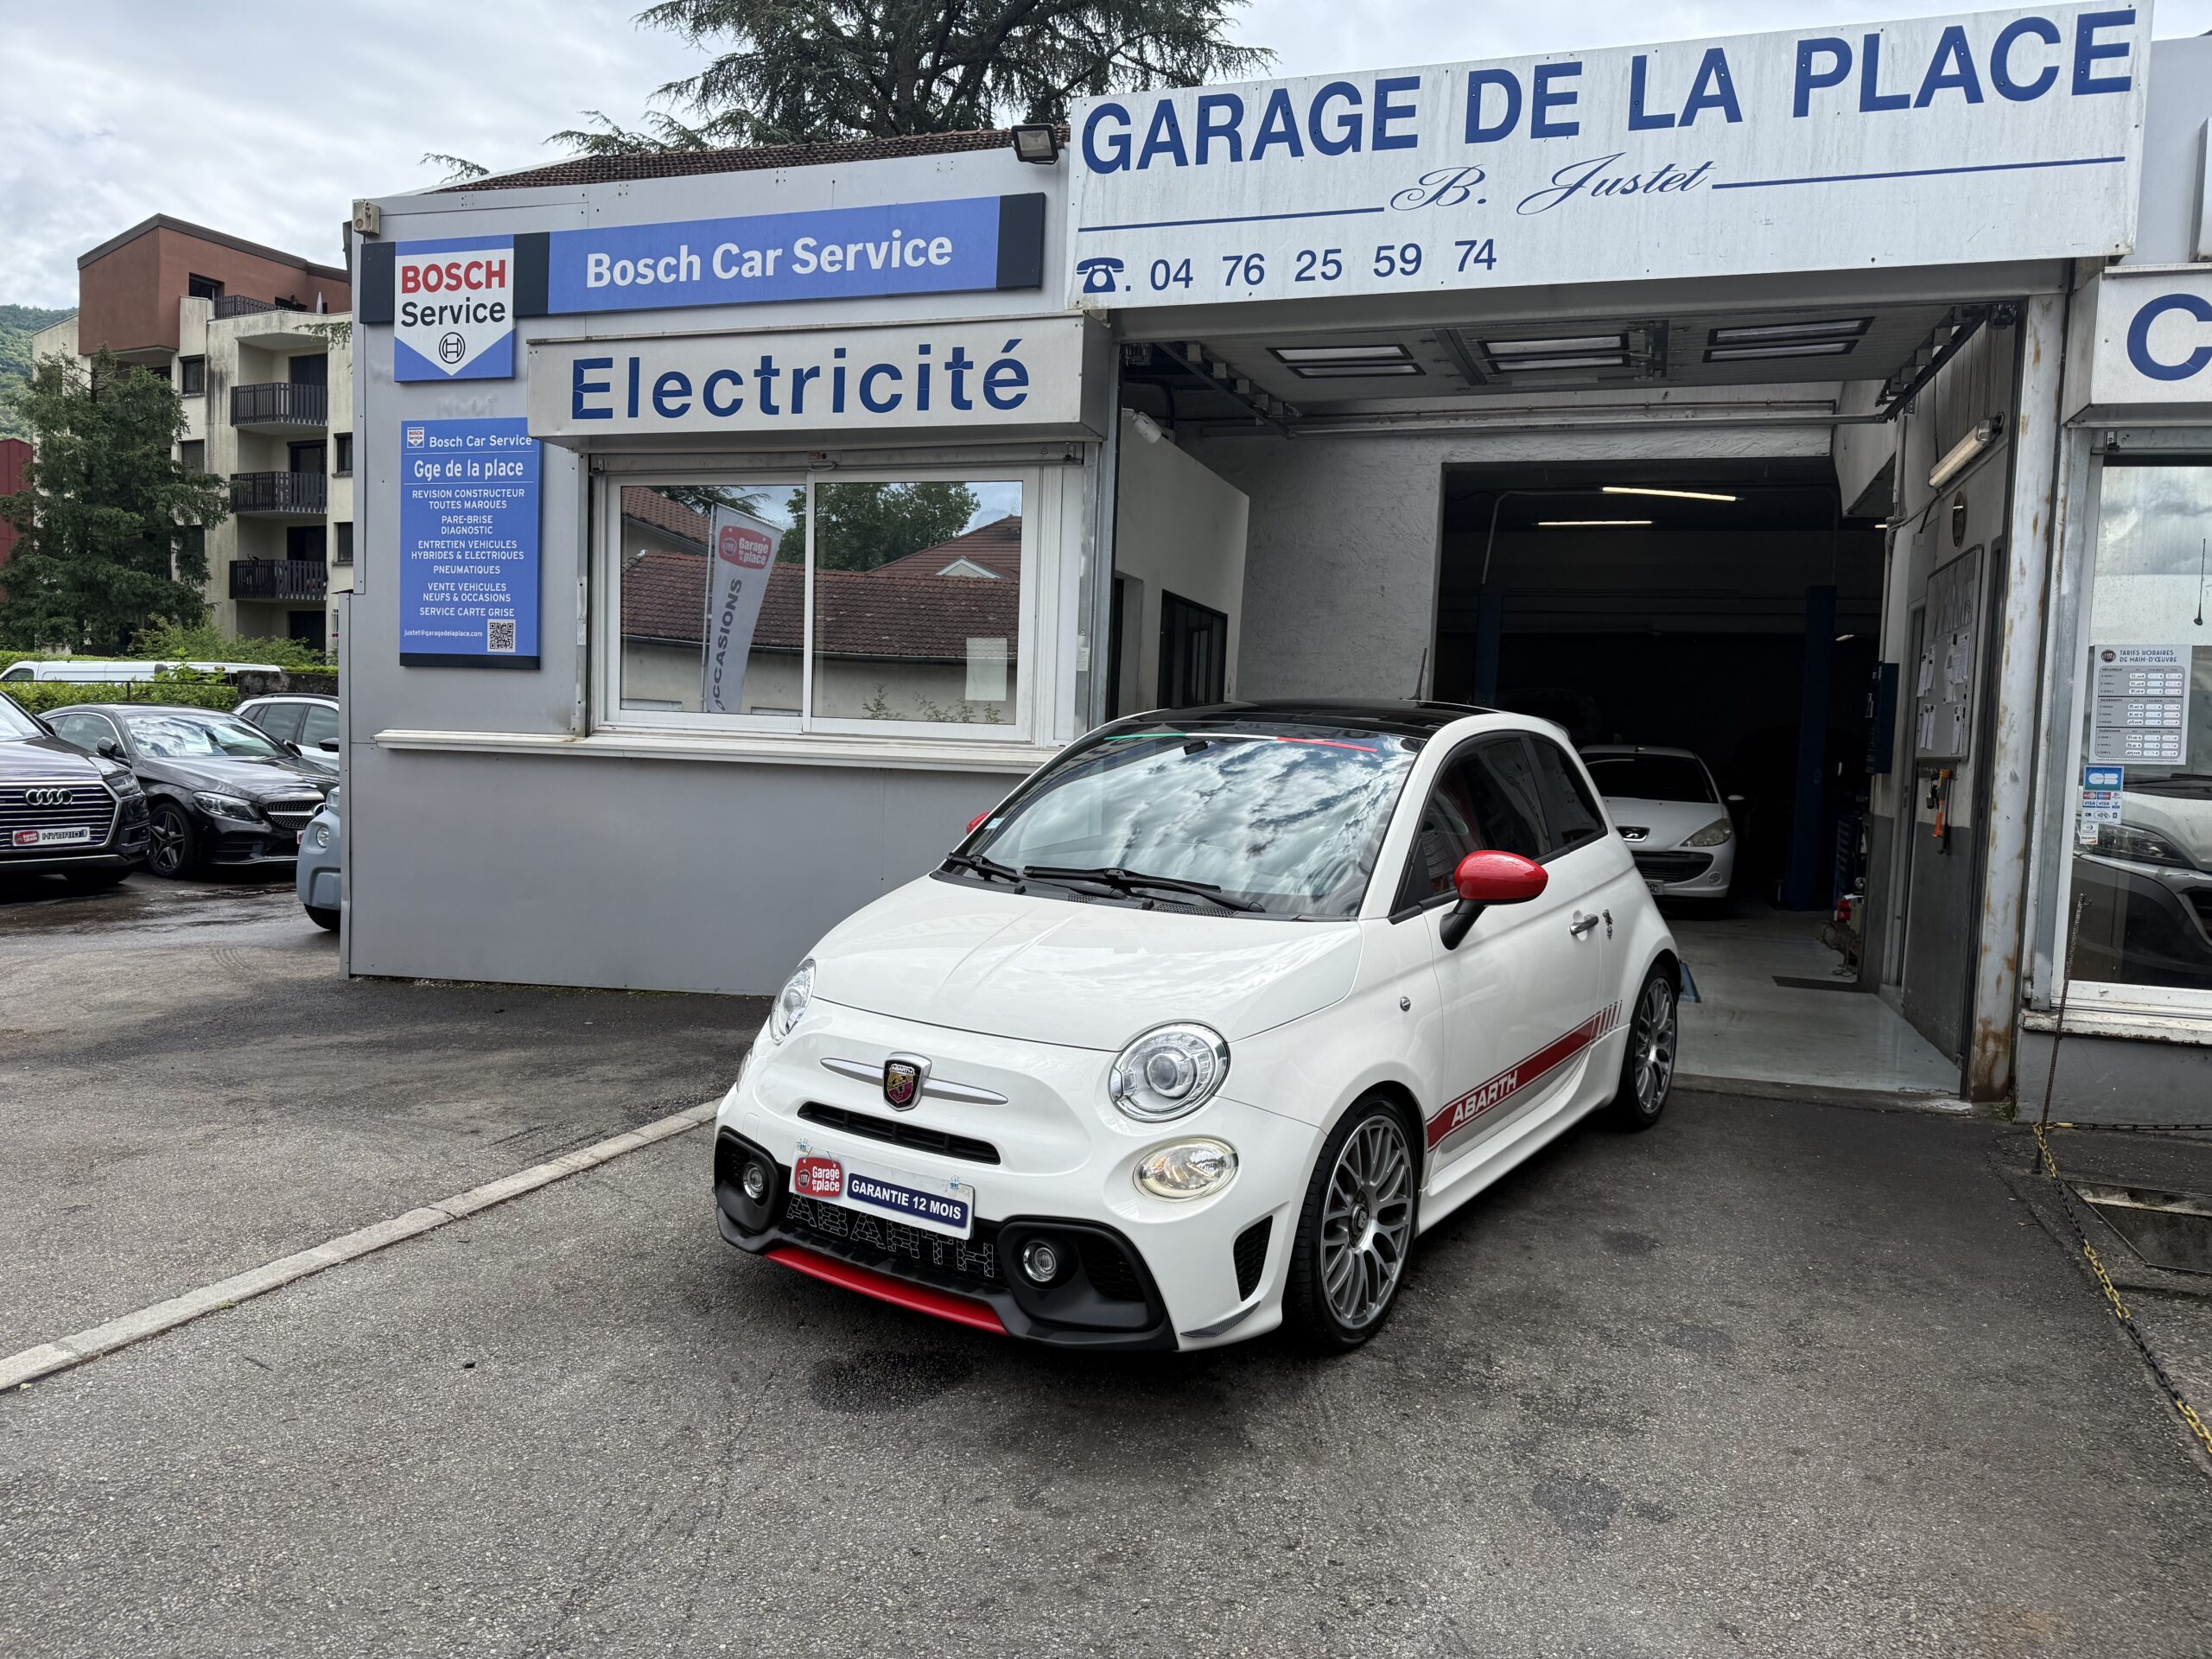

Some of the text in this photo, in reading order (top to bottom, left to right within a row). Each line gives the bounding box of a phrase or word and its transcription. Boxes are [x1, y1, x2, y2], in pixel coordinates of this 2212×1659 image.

[1082, 9, 2137, 175] GARAGE DE LA PLACE
[1390, 152, 1717, 215] B. Justet
[587, 229, 953, 289] Bosch Car Service
[1150, 238, 1497, 292] 04 76 25 59 74
[401, 259, 506, 294] BOSCH
[400, 299, 506, 327] Service
[2126, 293, 2212, 382] C
[572, 338, 1030, 421] Electricité
[429, 434, 532, 448] Bosch Car Service
[414, 458, 524, 481] Gge de la place
[412, 488, 524, 499] REVISION CONSTRUCTEUR
[429, 499, 507, 509] TOUTES MARQUES
[442, 515, 493, 524] PARE-BRISE
[441, 526, 493, 535] DIAGNOSTIC
[417, 540, 518, 549] ENTRETIEN VEHICULES
[739, 537, 769, 554] Garage
[411, 551, 524, 561] HYBRIDES & ELECTRIQUES
[433, 565, 501, 575] PNEUMATIQUES
[427, 582, 507, 592] VENTE VEHICULES
[423, 593, 512, 602] NEUFS & OCCASIONS
[419, 607, 515, 617] SERVICE CARTE GRISE
[713, 578, 742, 711] OCCASIONS
[891, 1065, 913, 1074] ABARTH
[1451, 1070, 1518, 1128] ABARTH
[812, 1166, 840, 1181] Garage
[817, 1179, 841, 1192] place
[852, 1179, 962, 1220] GARANTIE 12 MOIS
[786, 1193, 995, 1278] ABARTH
